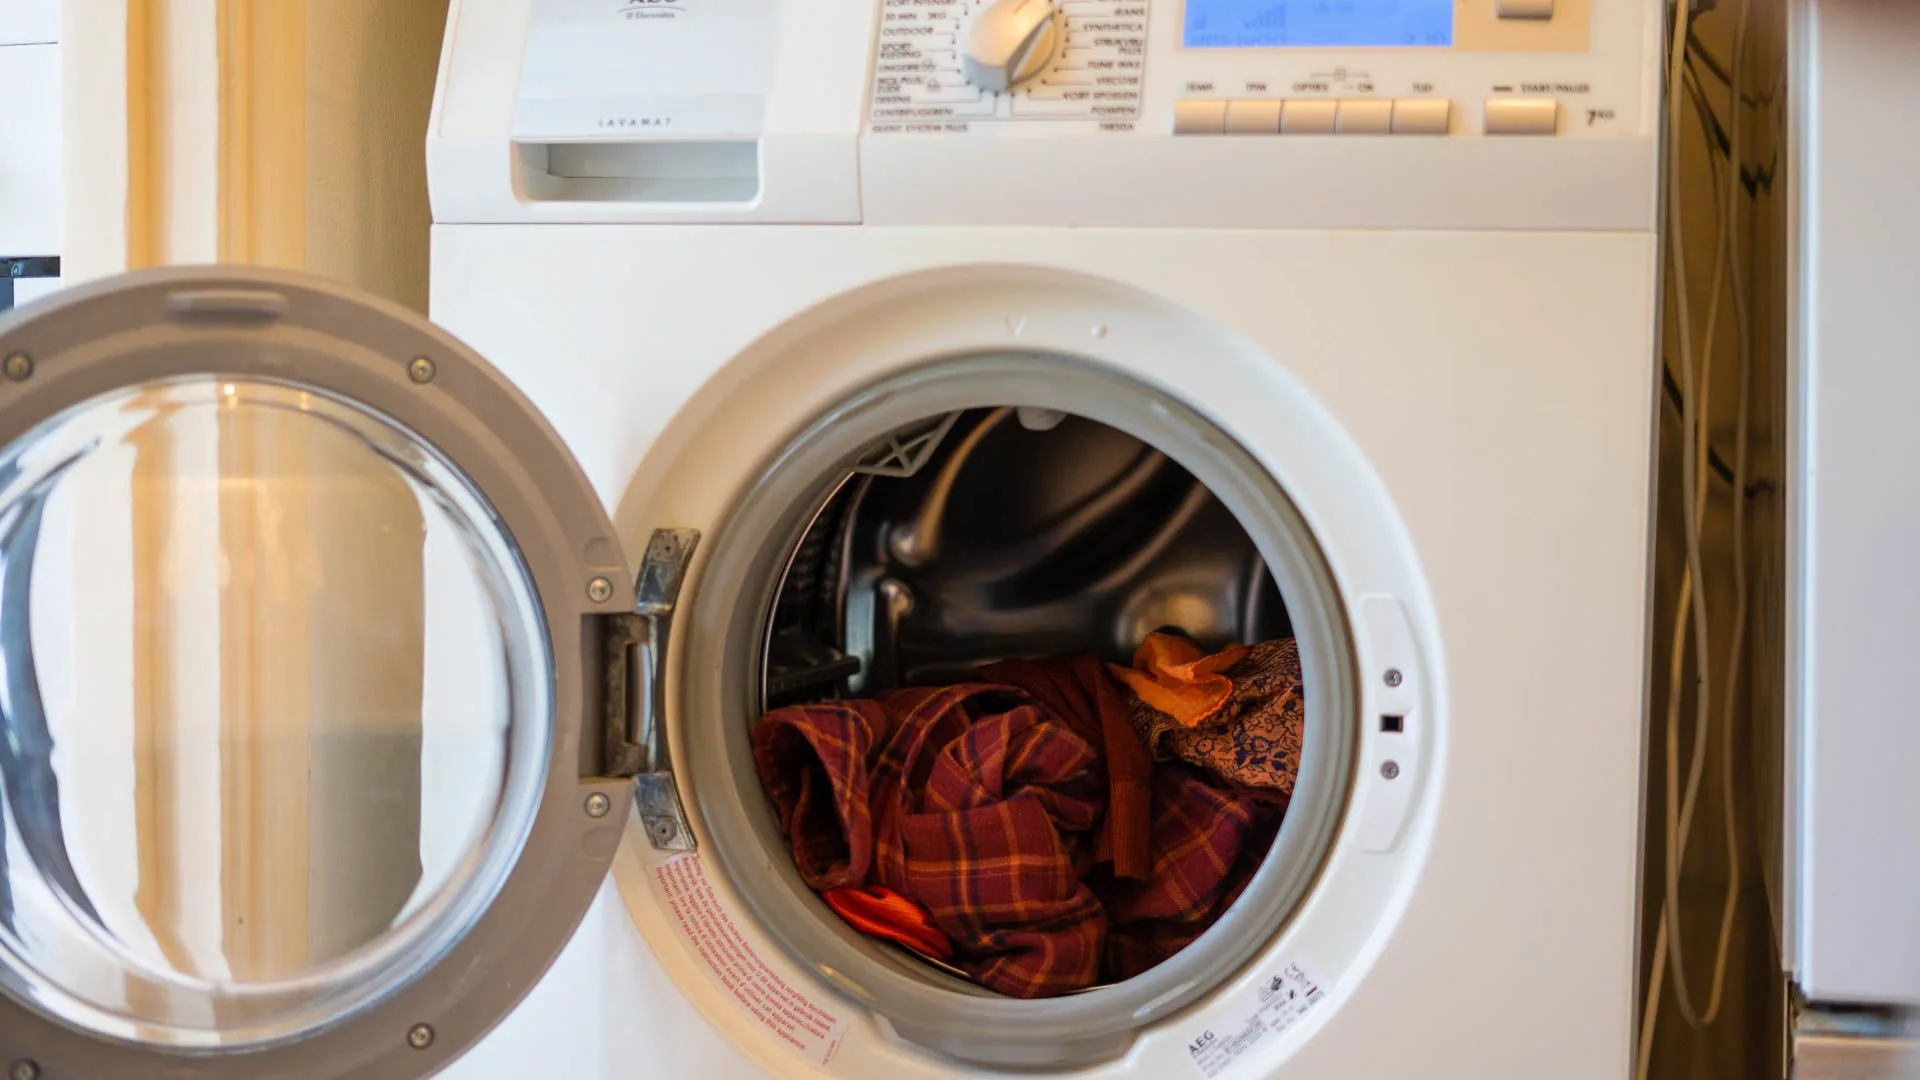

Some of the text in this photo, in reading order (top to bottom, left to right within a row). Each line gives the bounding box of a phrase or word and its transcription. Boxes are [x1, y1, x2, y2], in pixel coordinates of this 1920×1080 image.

[1114, 8, 1145, 17] JEANS
[882, 27, 934, 36] OUTDOOR
[1082, 23, 1143, 32] SYNTHETICA
[598, 117, 673, 127] LAVAMAT
[1188, 1029, 1215, 1054] AEG
